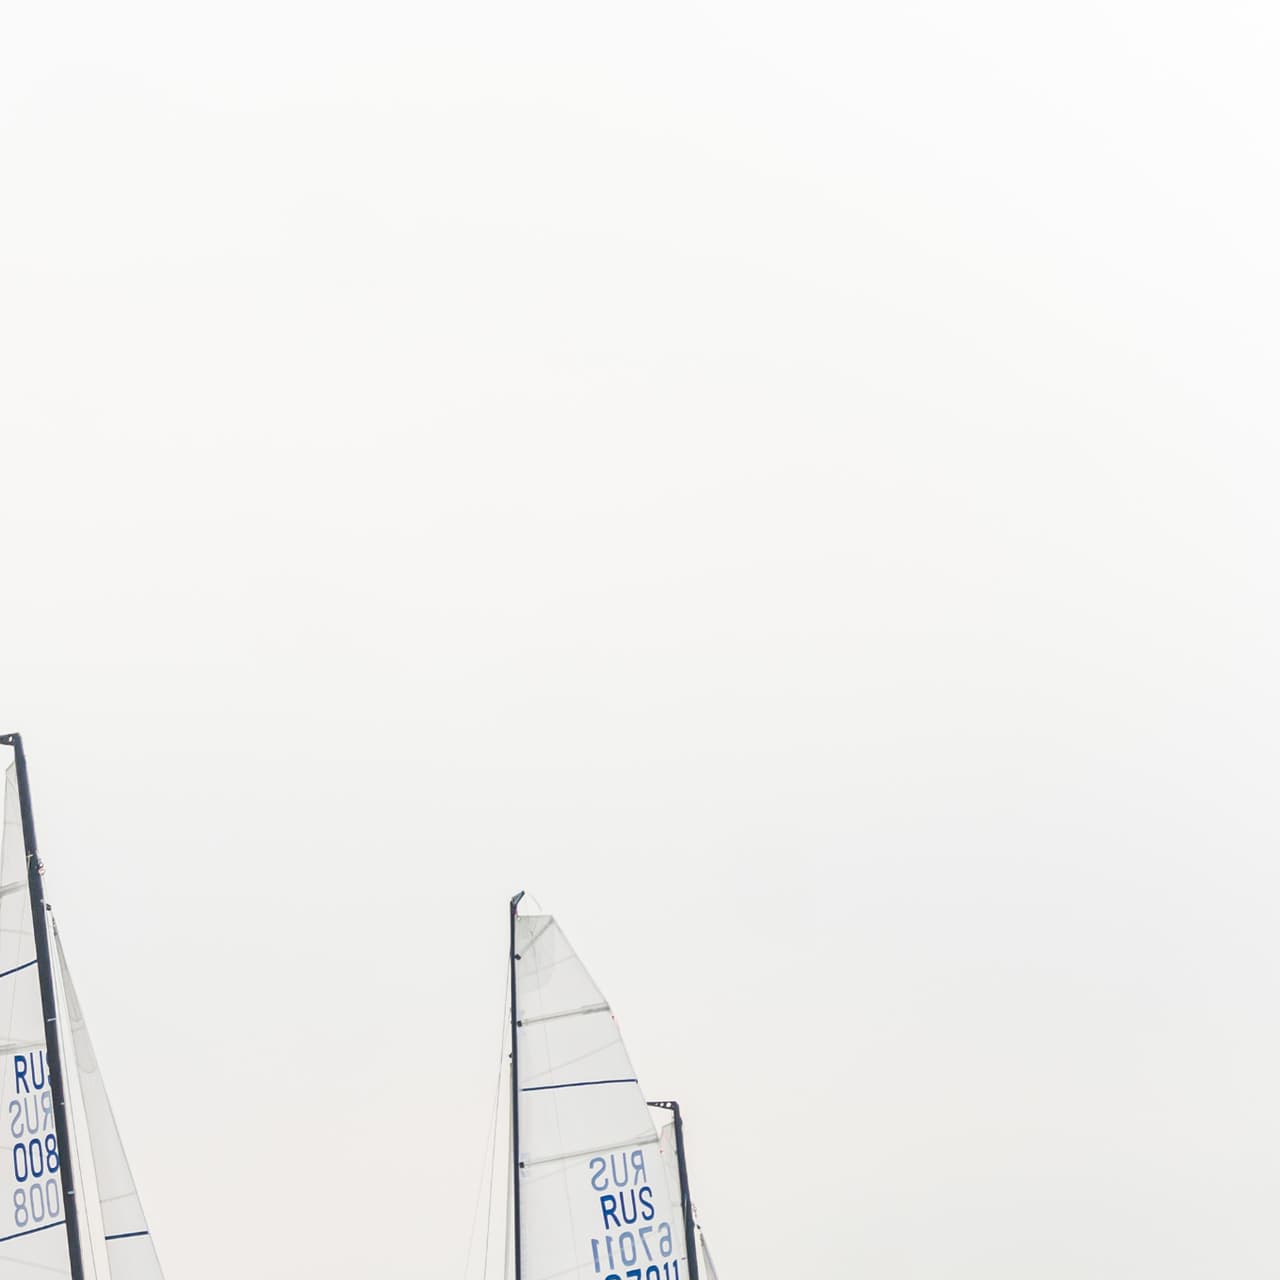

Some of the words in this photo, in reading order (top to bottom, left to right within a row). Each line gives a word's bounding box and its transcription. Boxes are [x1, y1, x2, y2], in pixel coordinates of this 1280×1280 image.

[14, 1051, 51, 1094] RU
[13, 1134, 60, 1182] 008
[600, 1186, 655, 1229] RUS
